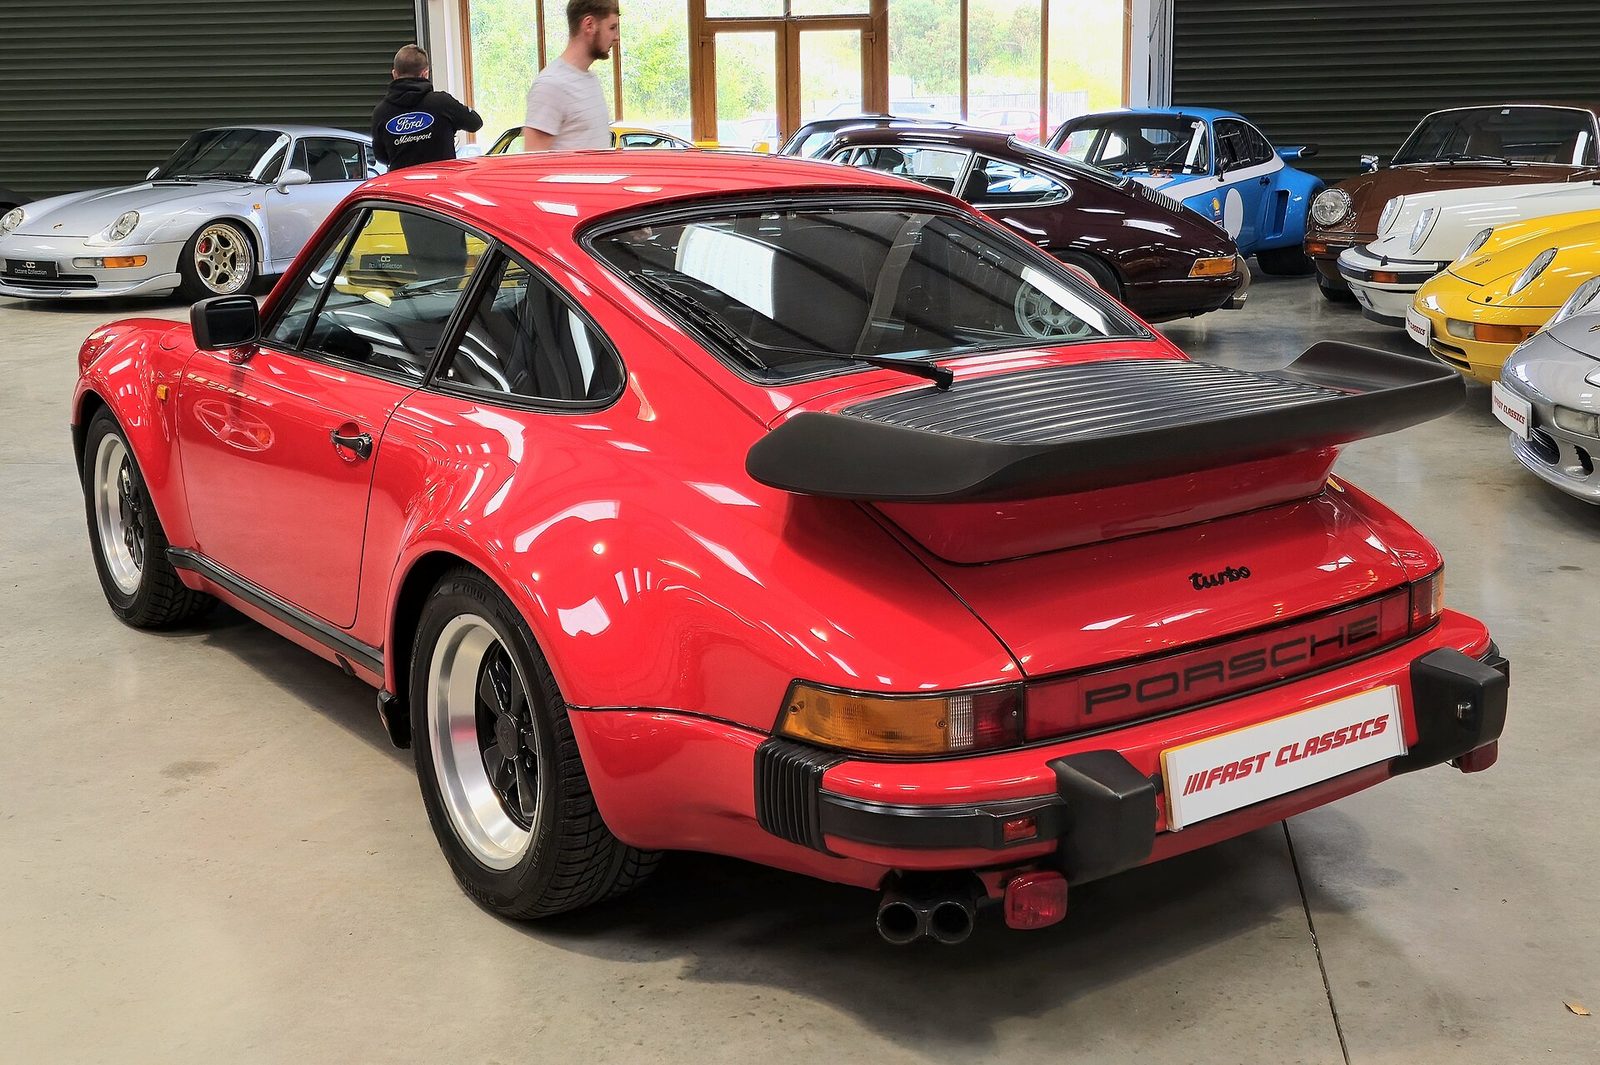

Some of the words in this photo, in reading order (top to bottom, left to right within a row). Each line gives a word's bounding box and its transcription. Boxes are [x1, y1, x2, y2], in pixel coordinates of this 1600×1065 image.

[395, 115, 424, 132] Ford
[393, 132, 432, 146] Motorsport
[1503, 404, 1526, 425] CLASSICS
[1188, 565, 1251, 591] turbo
[1084, 615, 1378, 715] PORSCHE
[1274, 714, 1390, 767] CLASSICS
